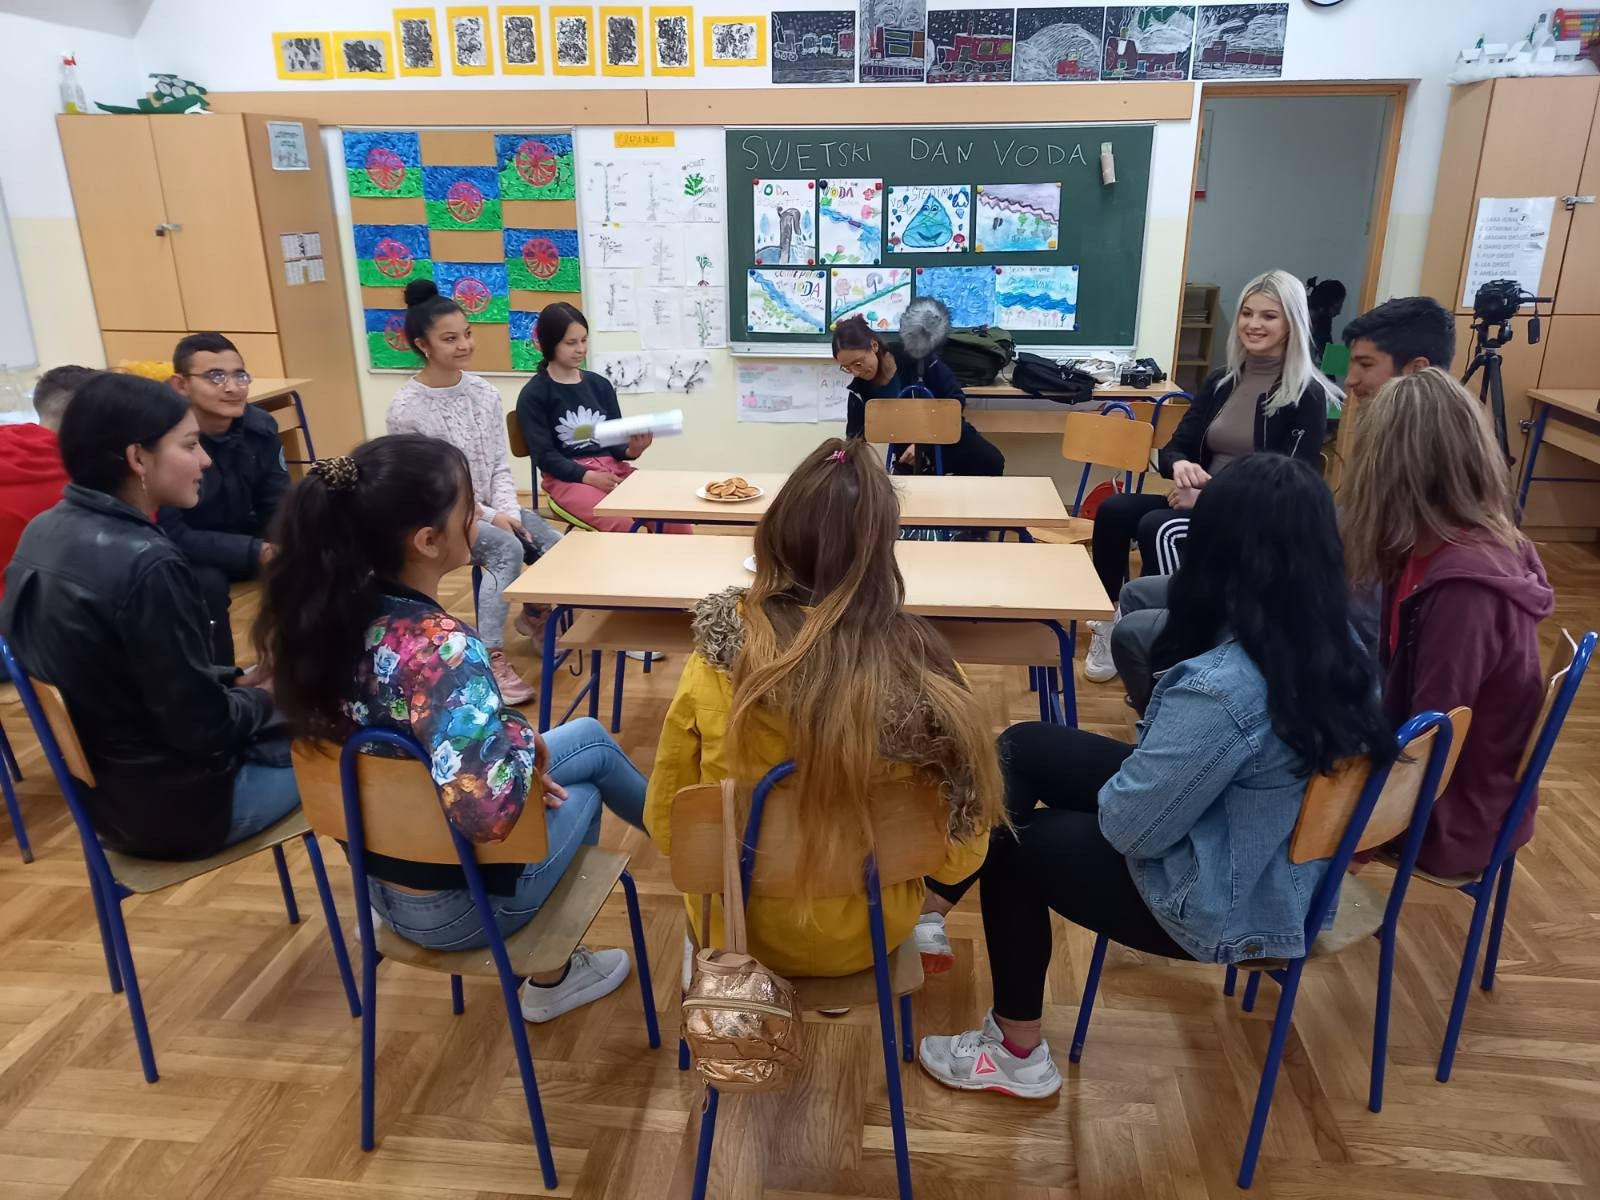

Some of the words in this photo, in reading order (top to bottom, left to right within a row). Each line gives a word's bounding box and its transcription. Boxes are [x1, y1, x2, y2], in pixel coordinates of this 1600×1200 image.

[742, 135, 872, 172] SVJETSKI
[910, 137, 974, 164] DAN
[993, 139, 1088, 167] VODA
